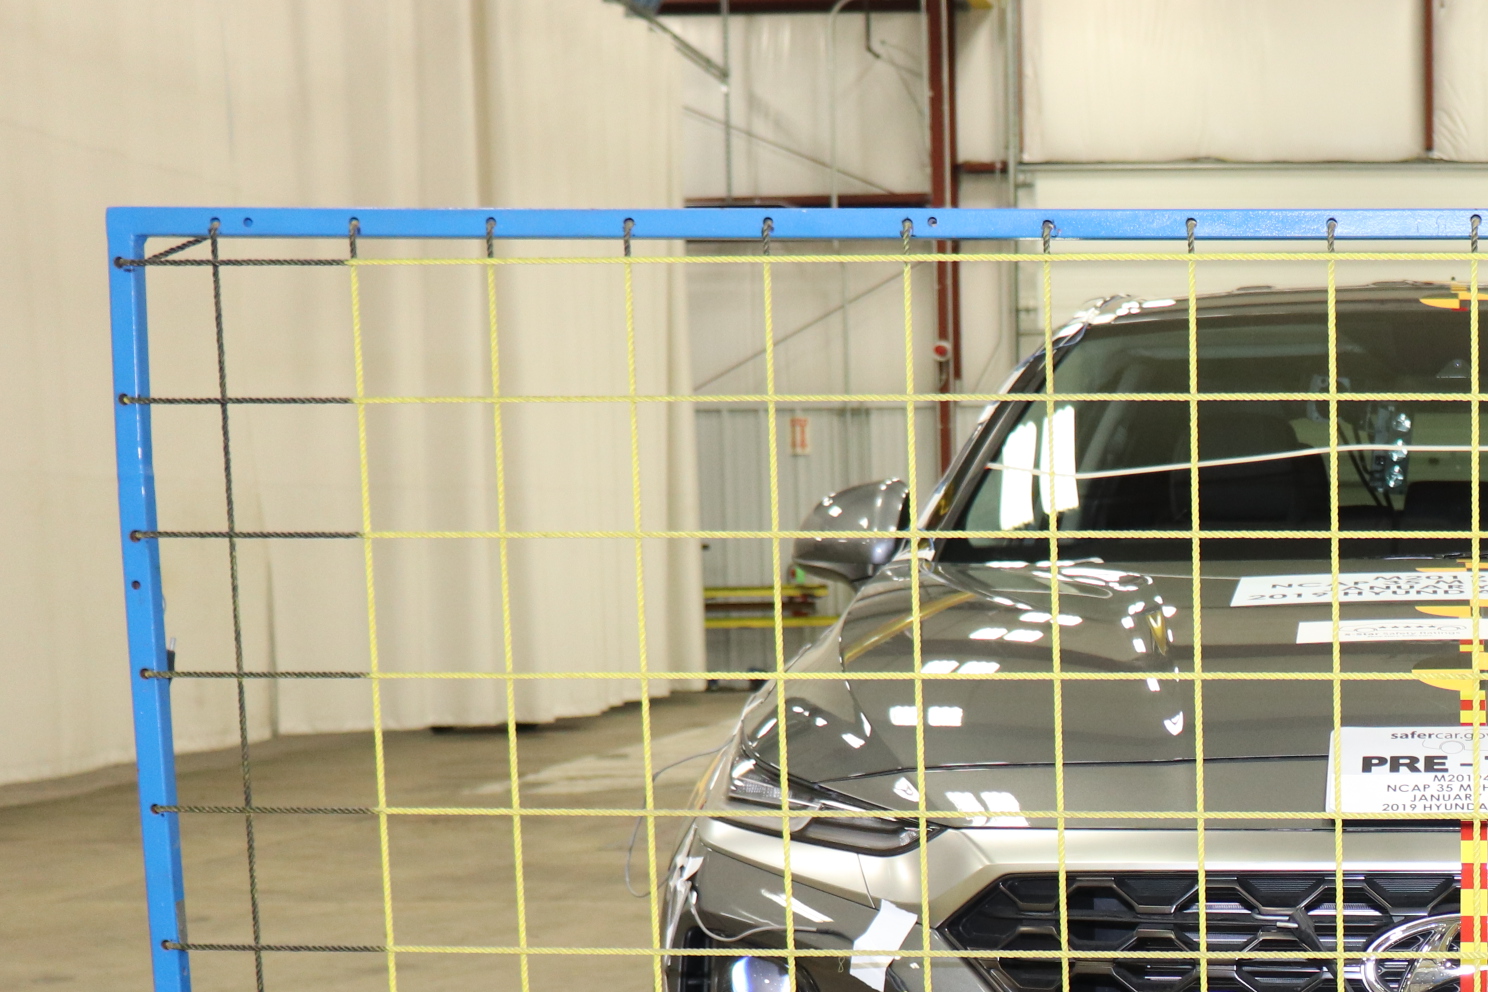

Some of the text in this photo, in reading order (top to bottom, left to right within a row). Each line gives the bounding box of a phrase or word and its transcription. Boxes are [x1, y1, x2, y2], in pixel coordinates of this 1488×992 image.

[1271, 581, 1369, 589] NCAP
[1249, 592, 1328, 600] 2019
[1361, 755, 1449, 774] PRE
[1386, 784, 1431, 793] NCAP
[1436, 784, 1453, 793] 35
[1410, 793, 1481, 803] JANUAR
[1382, 803, 1418, 812] 2019
